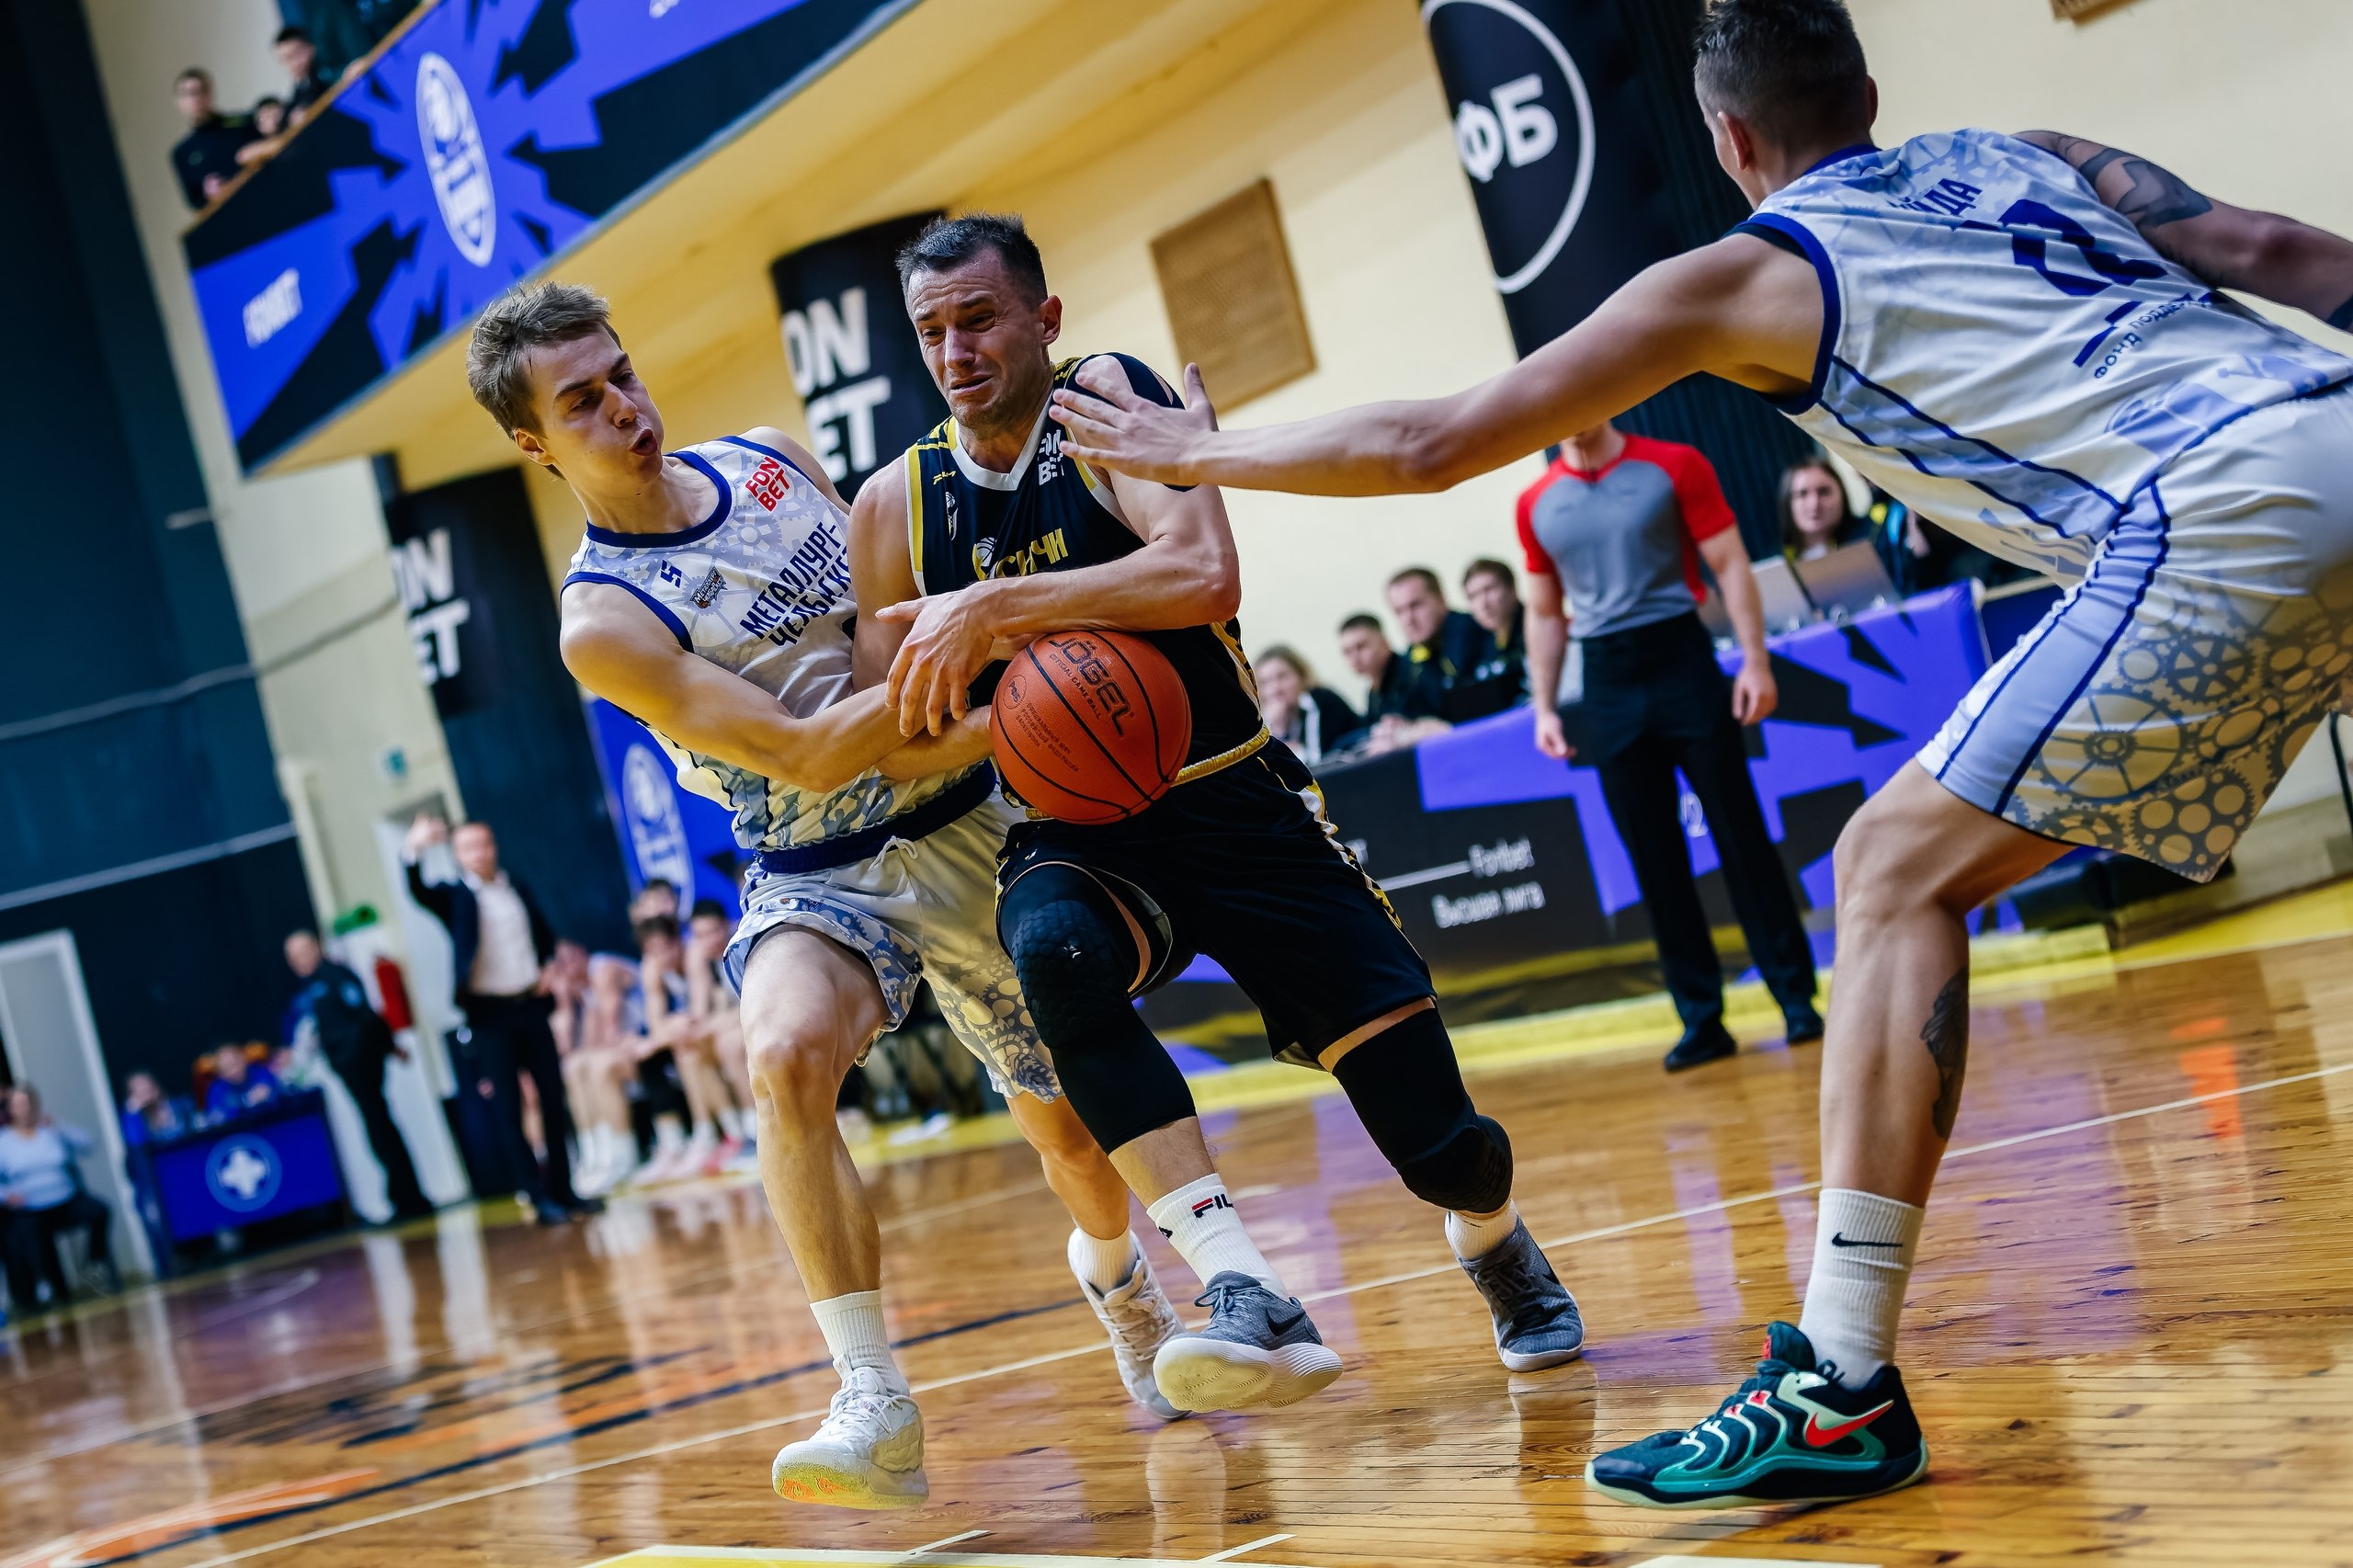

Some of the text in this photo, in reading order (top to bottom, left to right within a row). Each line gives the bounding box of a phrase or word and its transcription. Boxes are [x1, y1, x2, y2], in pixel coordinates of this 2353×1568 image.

[2094, 333, 2143, 378] ФОНД
[745, 457, 780, 498] FON
[758, 470, 790, 511] BET
[1048, 638, 1131, 738] JÖGEL
[1071, 676, 1089, 699] GAME
[1086, 698, 1101, 720] BALL
